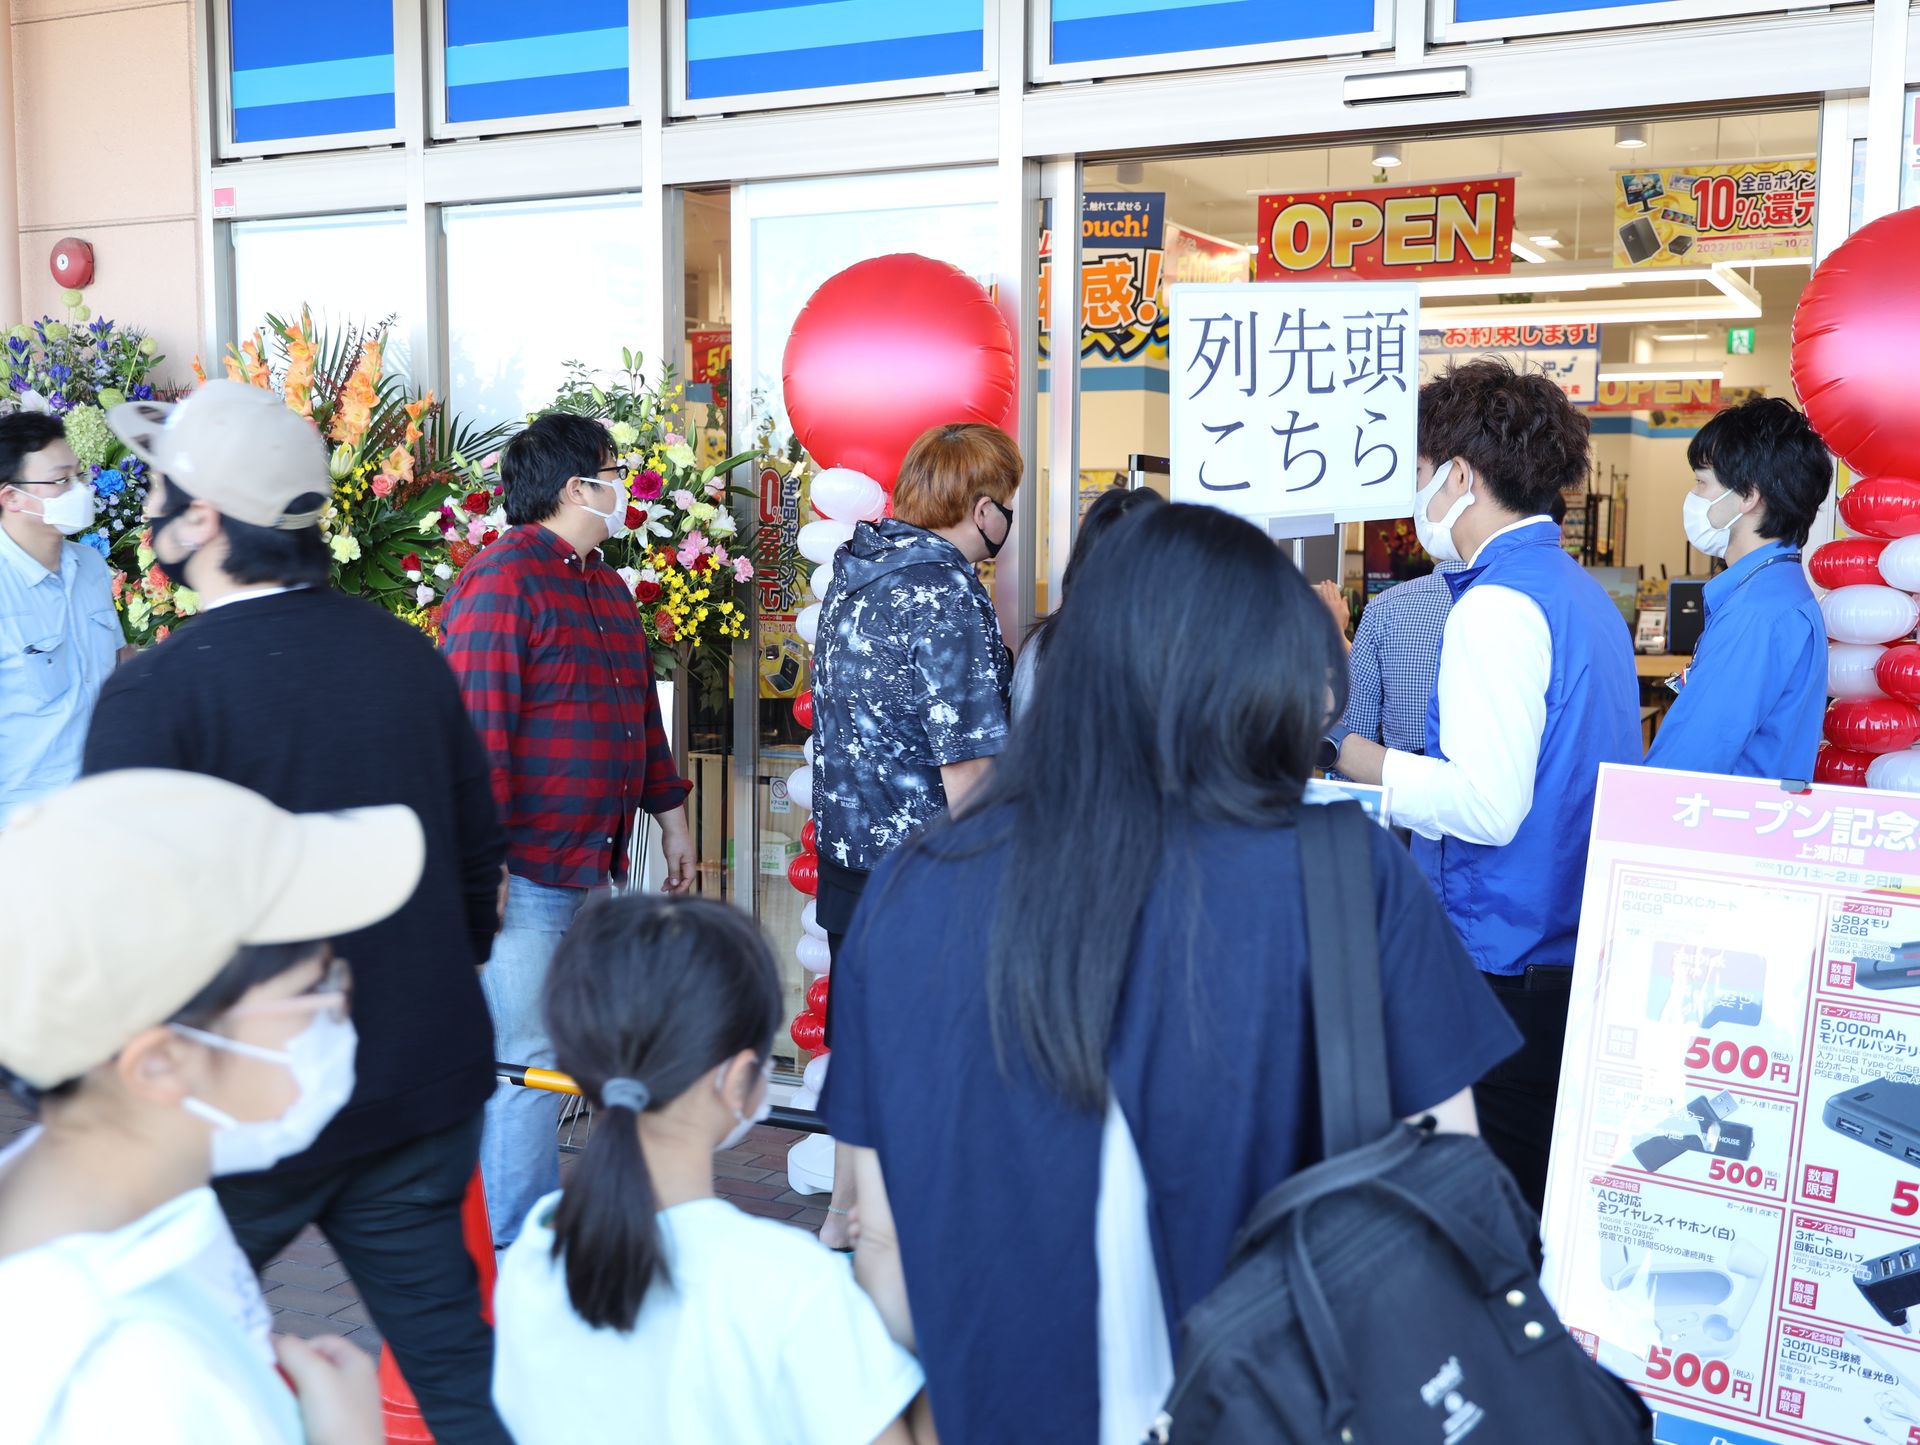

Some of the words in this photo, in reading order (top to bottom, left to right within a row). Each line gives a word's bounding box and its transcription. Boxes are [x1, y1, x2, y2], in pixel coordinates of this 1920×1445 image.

[1271, 192, 1497, 271] OPEN
[1187, 308, 1408, 400] 列先頭
[1600, 379, 1711, 406] OPEN
[1199, 408, 1398, 492] こちら
[1672, 793, 1920, 851] オープン記念
[1843, 902, 1892, 917] ープン記念特価
[1832, 914, 1890, 929] USBメモリ
[1831, 924, 1868, 936] 32GB
[1829, 973, 1851, 986] 限定
[1822, 1007, 1879, 1022] オープン記念特価
[1820, 1019, 1906, 1042] 5,000mAh
[1820, 1032, 1920, 1057] モバイルバッテリ
[1814, 1069, 1859, 1084] PSE適合品
[1807, 1168, 1834, 1185] 数量
[1806, 1182, 1832, 1198] 限定
[1797, 1218, 1854, 1237] オープン記念特価
[1795, 1230, 1833, 1245] 3ポート
[1794, 1241, 1865, 1262] 回転USBハブ
[1794, 1281, 1815, 1295] 数量
[1792, 1292, 1813, 1306] 限定
[1782, 1338, 1861, 1365] 30灯USB接続
[1781, 1390, 1801, 1404] 数量
[1779, 1400, 1800, 1415] 限定
